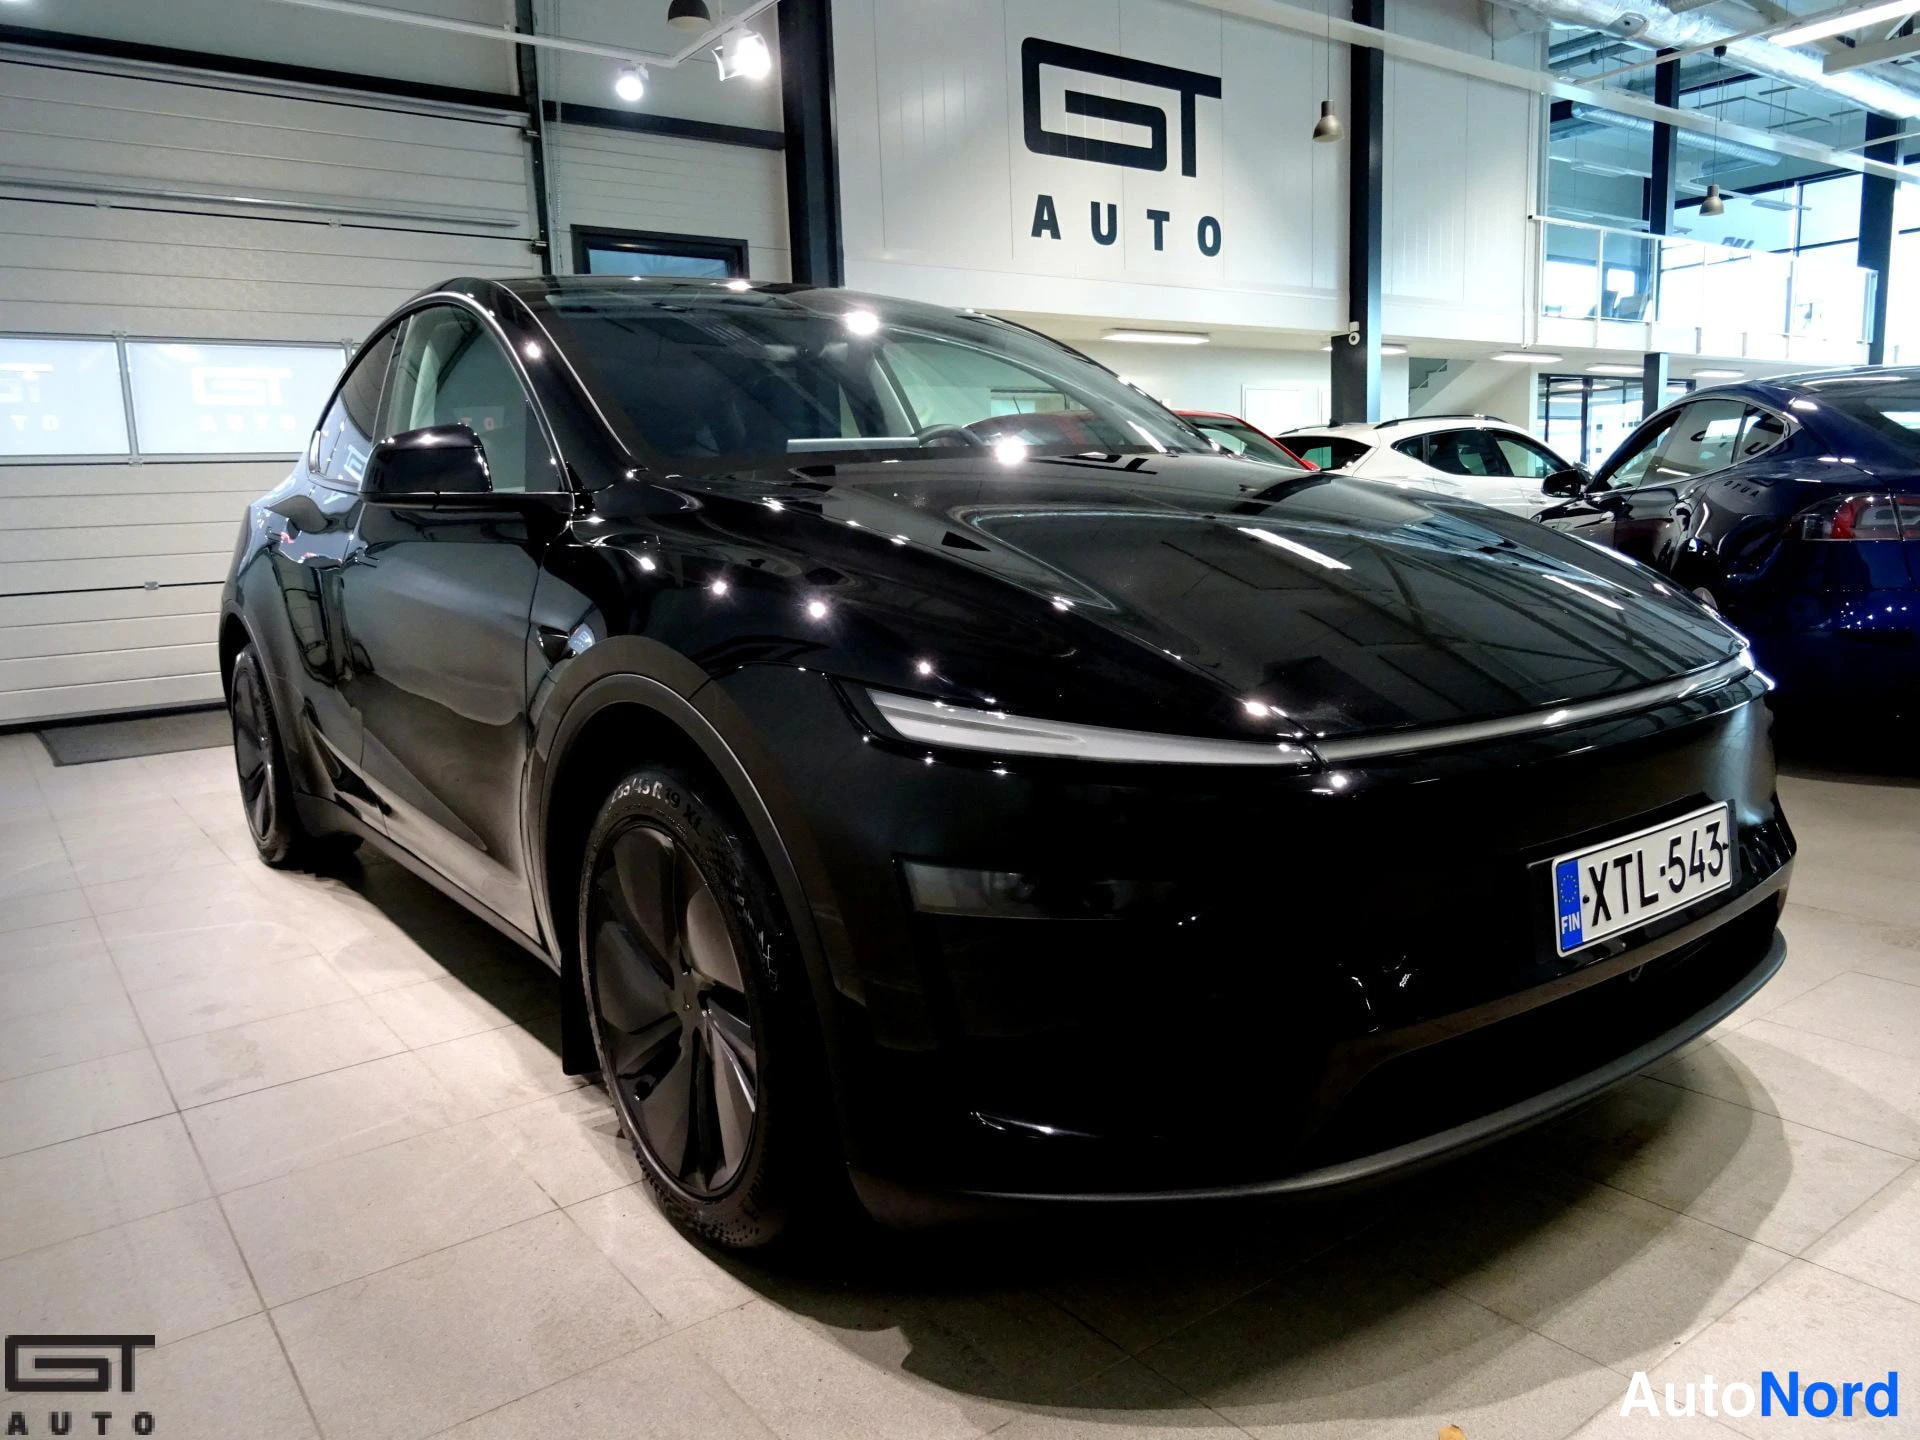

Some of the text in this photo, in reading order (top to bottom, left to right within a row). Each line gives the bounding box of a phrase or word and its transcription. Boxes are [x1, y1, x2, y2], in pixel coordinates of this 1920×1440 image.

[1021, 37, 1222, 178] GT
[1031, 194, 1222, 257] AUTO
[1588, 820, 1725, 927] XTL-543
[1561, 911, 1581, 935] FIN
